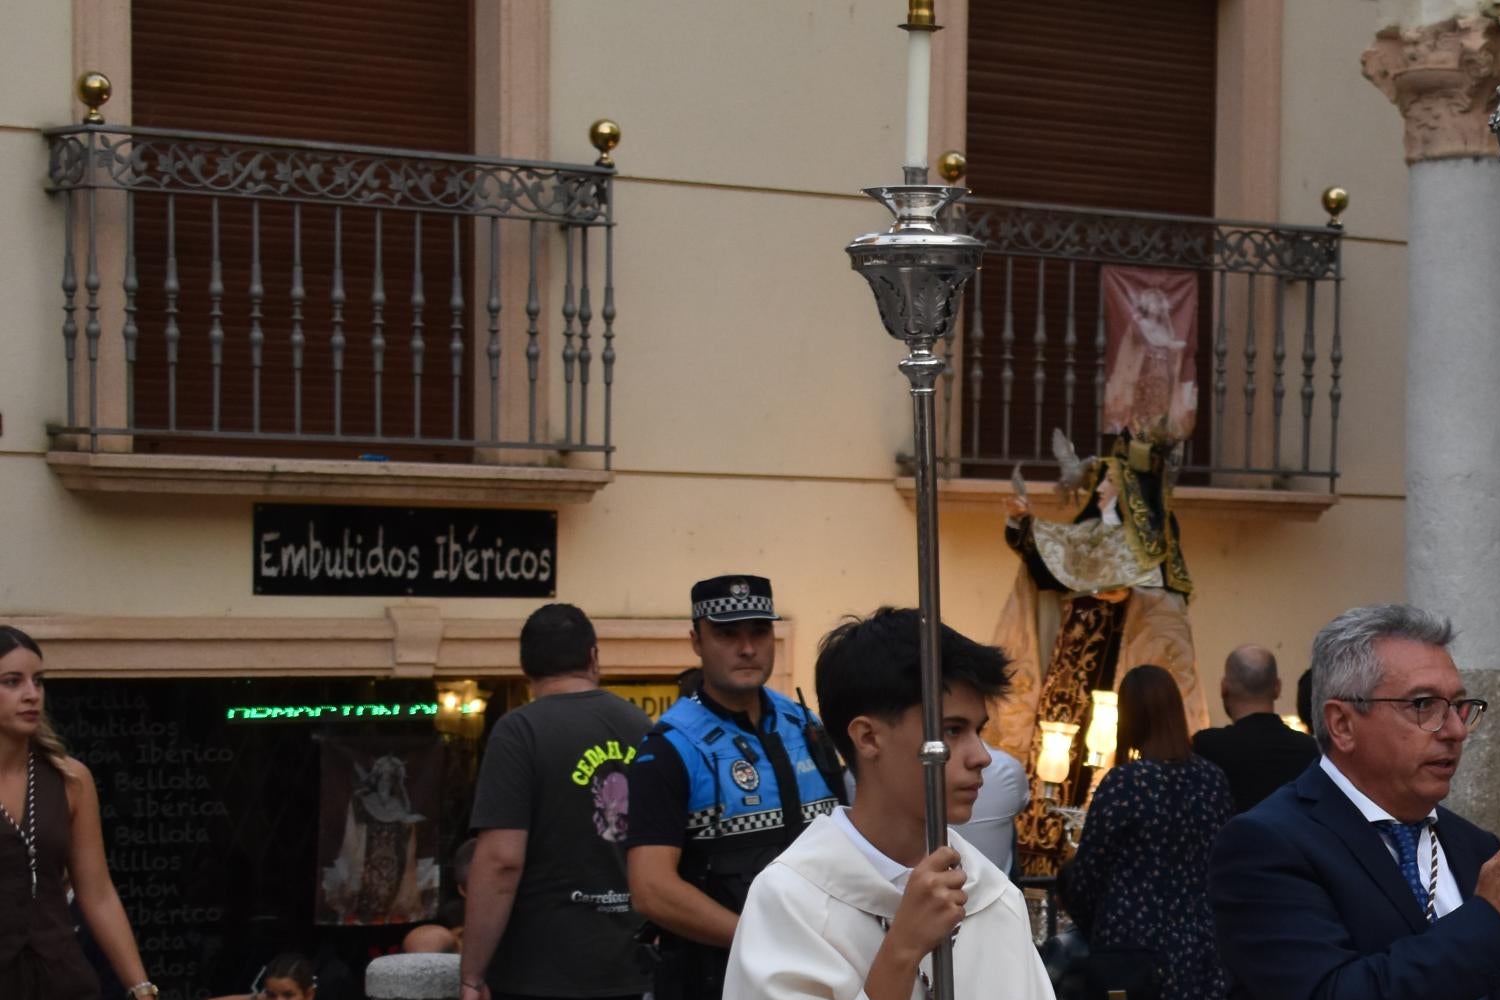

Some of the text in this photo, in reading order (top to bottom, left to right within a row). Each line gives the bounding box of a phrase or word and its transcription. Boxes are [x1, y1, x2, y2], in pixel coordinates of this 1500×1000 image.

[259, 520, 552, 582] Embutidos Ibéricos
[47, 686, 150, 711] orcilla
[135, 737, 235, 764] Ibérico
[572, 745, 609, 785] CEDA
[606, 740, 623, 760] EL
[114, 767, 211, 792] Bellota
[132, 791, 229, 818] Ibérica
[115, 821, 211, 846] Bellota
[571, 889, 631, 904] Carrefour
